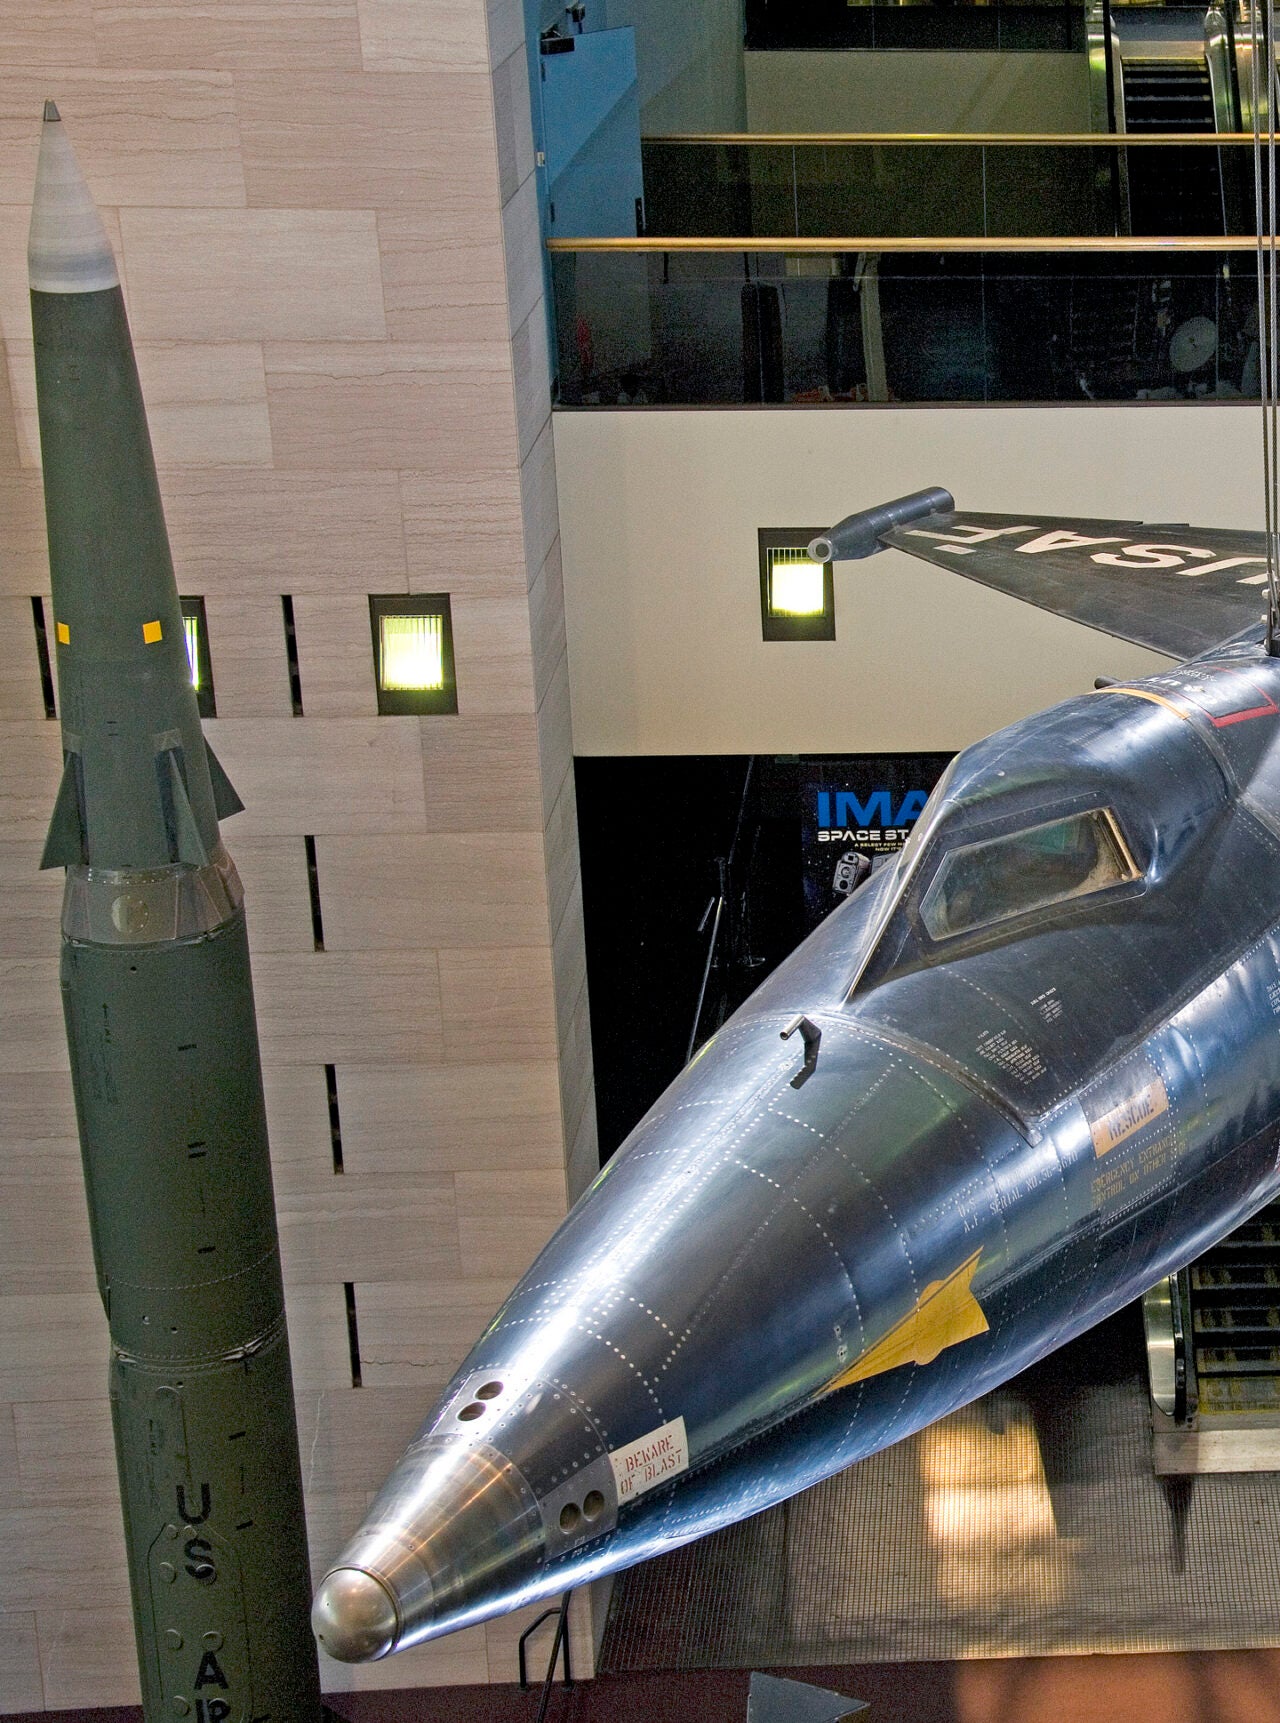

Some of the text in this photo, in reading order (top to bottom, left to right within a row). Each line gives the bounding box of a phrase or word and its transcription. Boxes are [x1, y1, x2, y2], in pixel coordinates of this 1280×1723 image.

[817, 829, 881, 842] SPACE
[620, 1449, 682, 1495] OF BLAST
[625, 1434, 674, 1473] BEWARE
